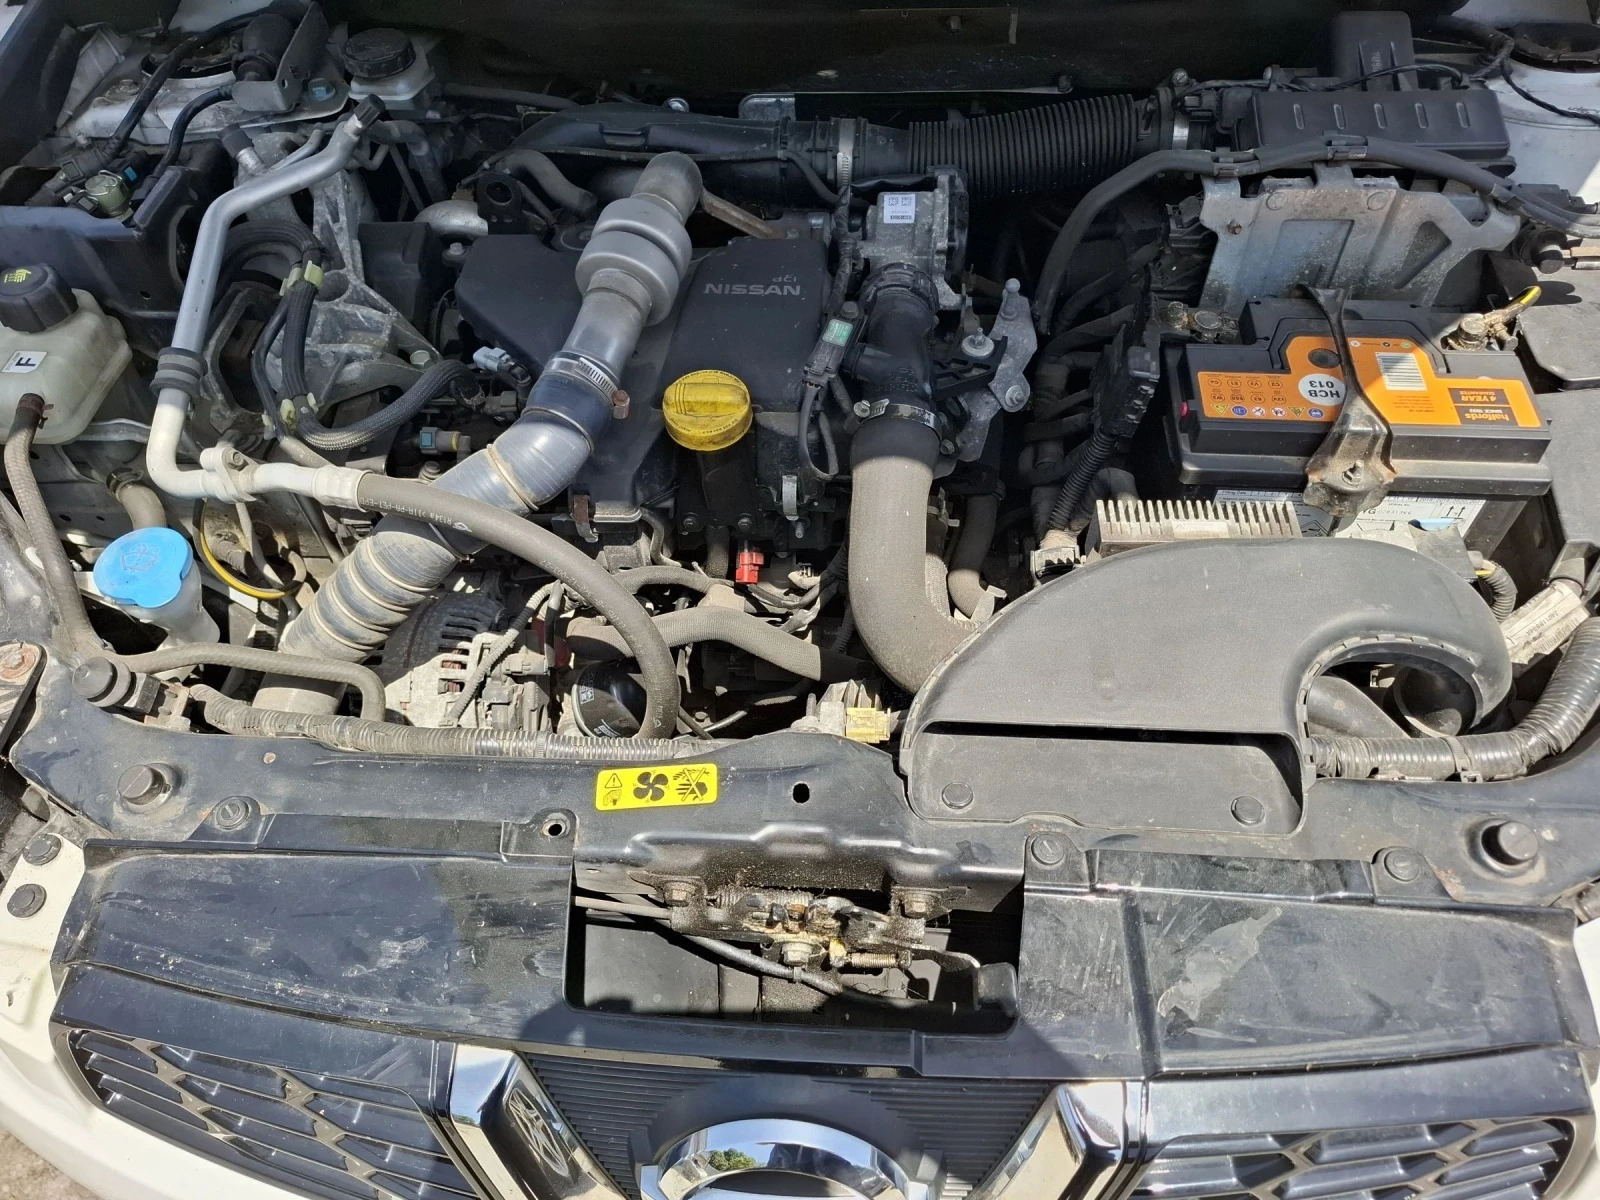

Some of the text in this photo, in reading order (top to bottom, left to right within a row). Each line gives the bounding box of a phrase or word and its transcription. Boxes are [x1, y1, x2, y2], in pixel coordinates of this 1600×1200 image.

[704, 283, 801, 296] NISSAN
[14, 357, 37, 367] F
[1309, 380, 1334, 388] 013
[1308, 390, 1340, 398] HCB
